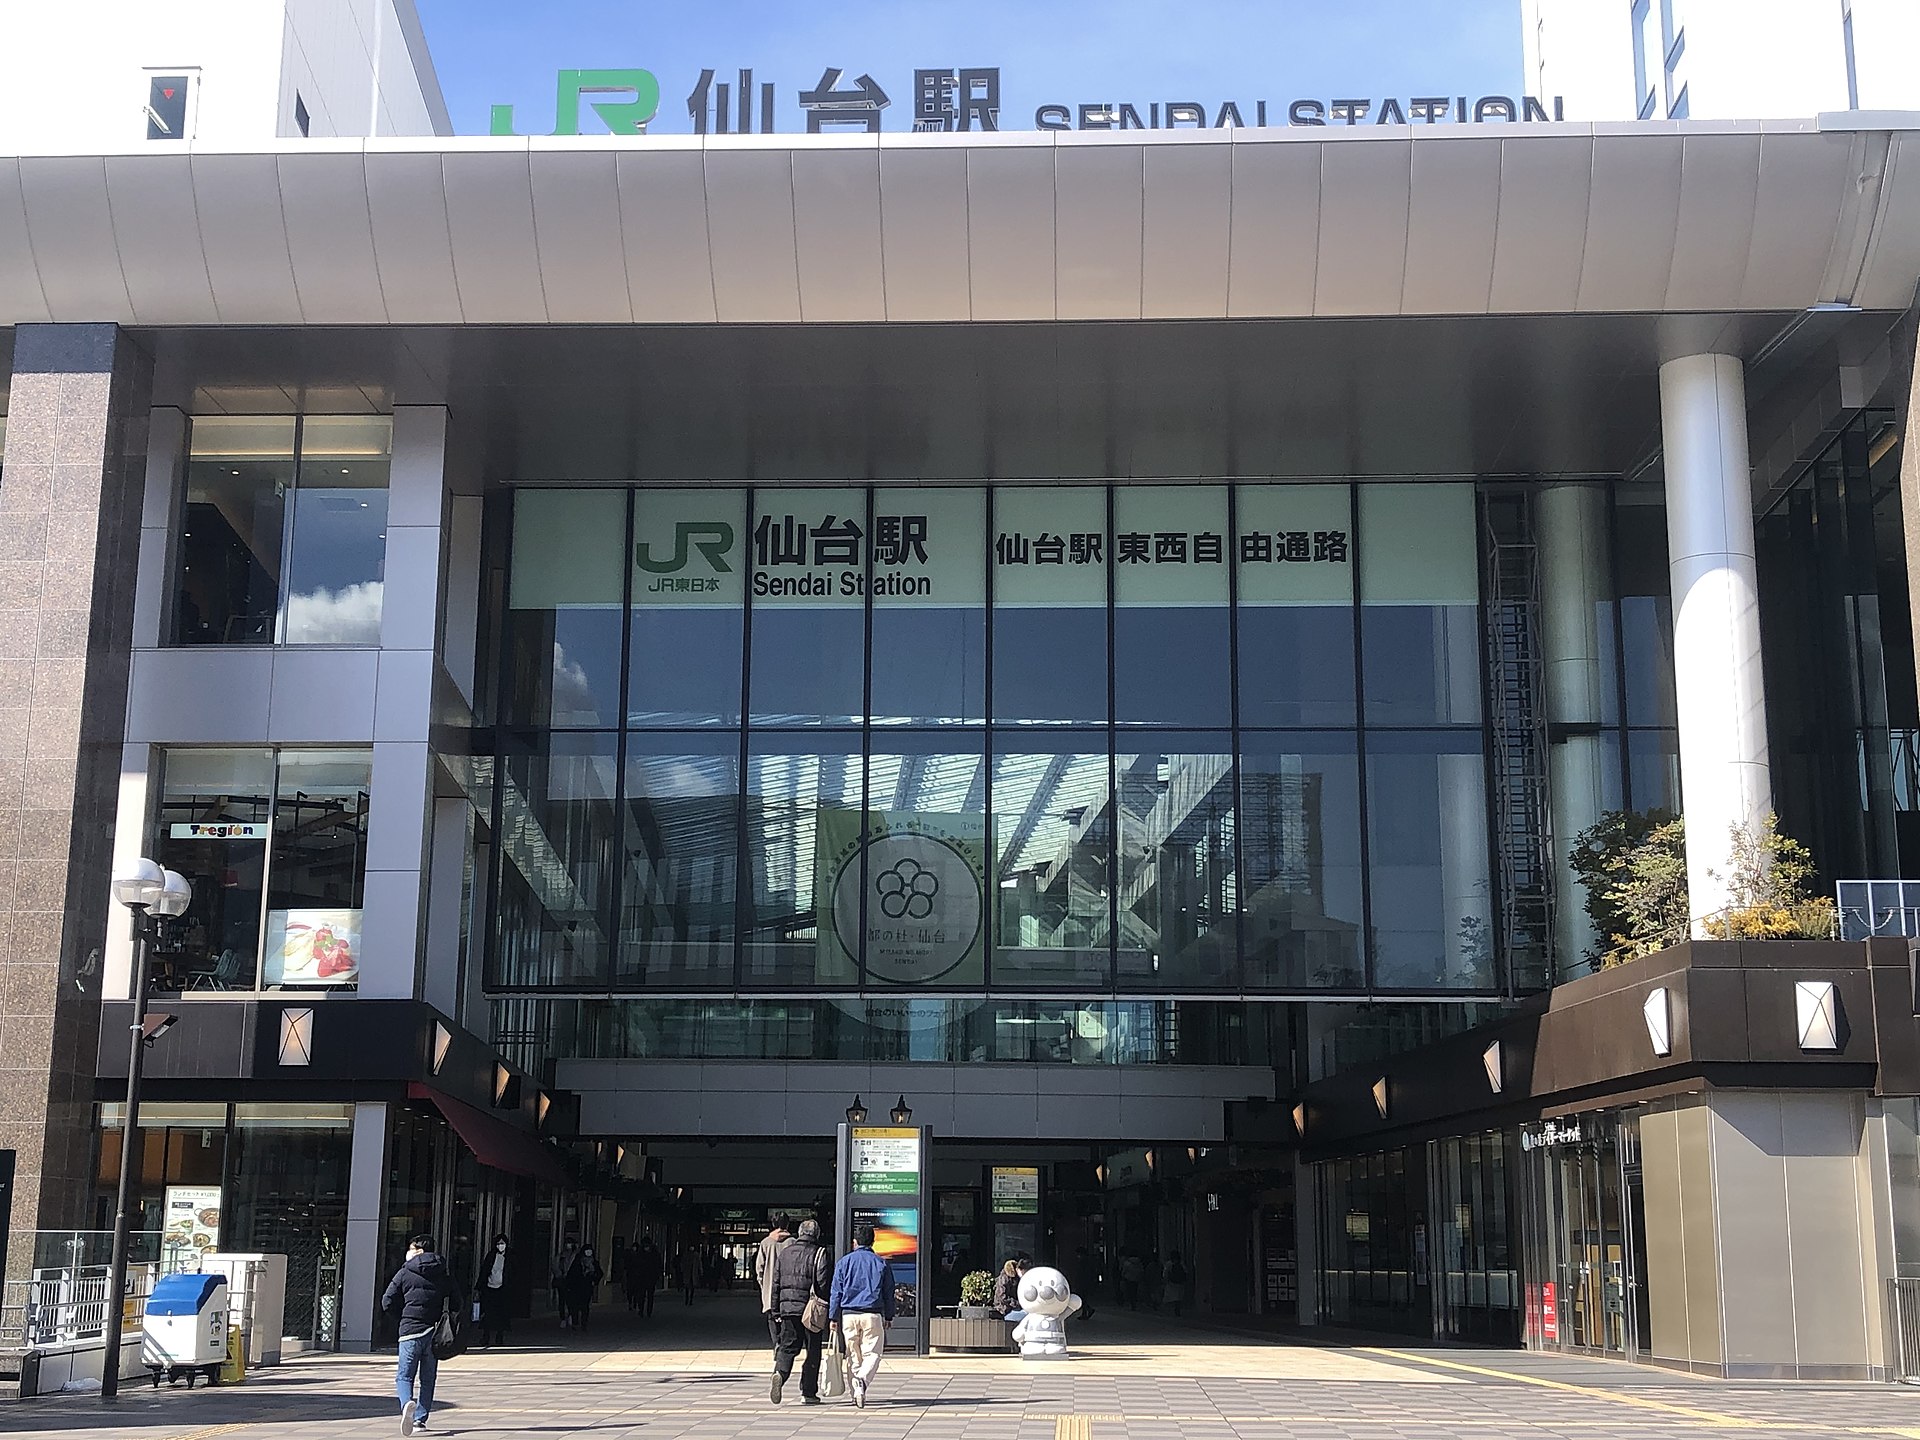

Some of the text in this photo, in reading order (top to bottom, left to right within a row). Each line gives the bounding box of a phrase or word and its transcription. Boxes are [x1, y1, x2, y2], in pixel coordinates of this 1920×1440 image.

[687, 67, 1000, 135] 仙台駅
[1035, 96, 1564, 131] SENDAI STATION
[636, 522, 734, 574] JR
[754, 514, 929, 566] 仙台駅
[648, 578, 720, 593] JR東日本
[753, 571, 931, 596] Sendai Station
